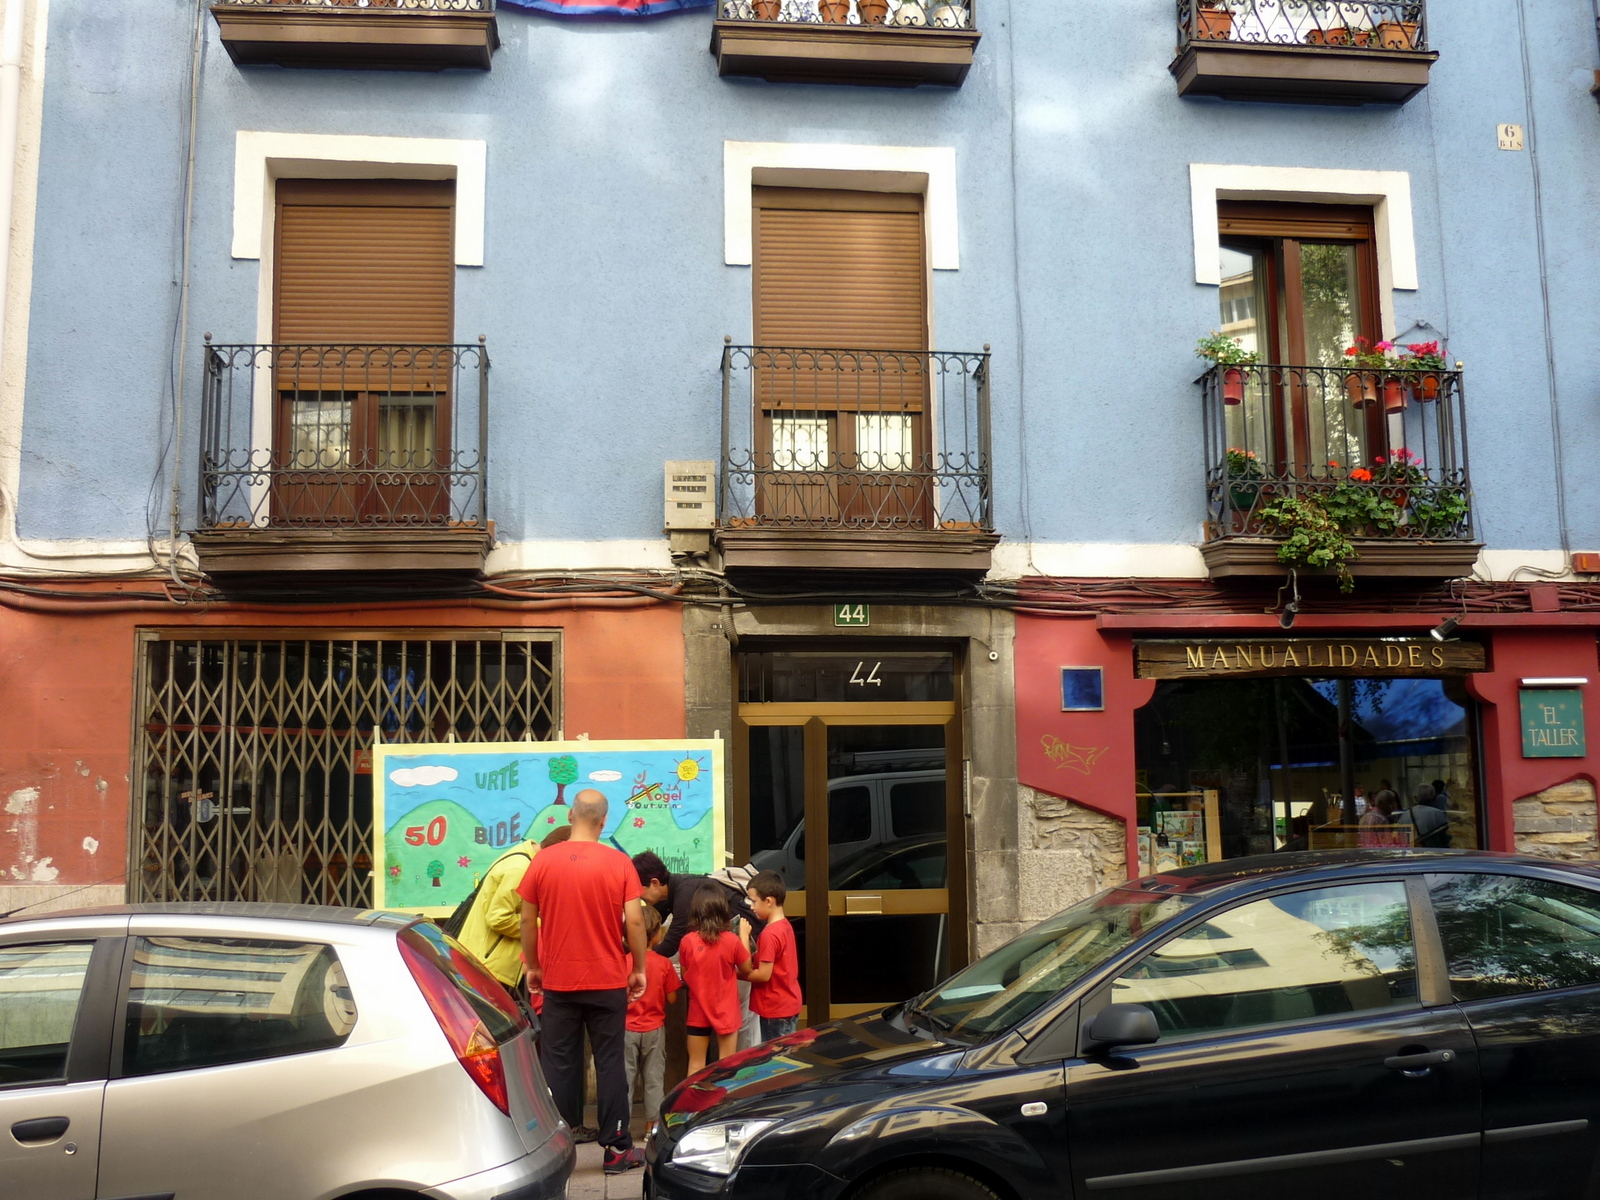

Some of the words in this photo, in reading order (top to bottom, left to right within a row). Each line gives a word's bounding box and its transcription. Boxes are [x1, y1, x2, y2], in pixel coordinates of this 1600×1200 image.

[1504, 125, 1515, 138] 6
[1500, 140, 1522, 148] BIS
[839, 604, 865, 622] 44
[1185, 645, 1444, 669] MANUALIDADES
[849, 661, 882, 686] 44
[1543, 706, 1561, 724] EL
[1528, 728, 1579, 746] TALLER
[475, 760, 519, 791] URTE
[405, 815, 447, 846] 50
[474, 812, 520, 847] BIDE
